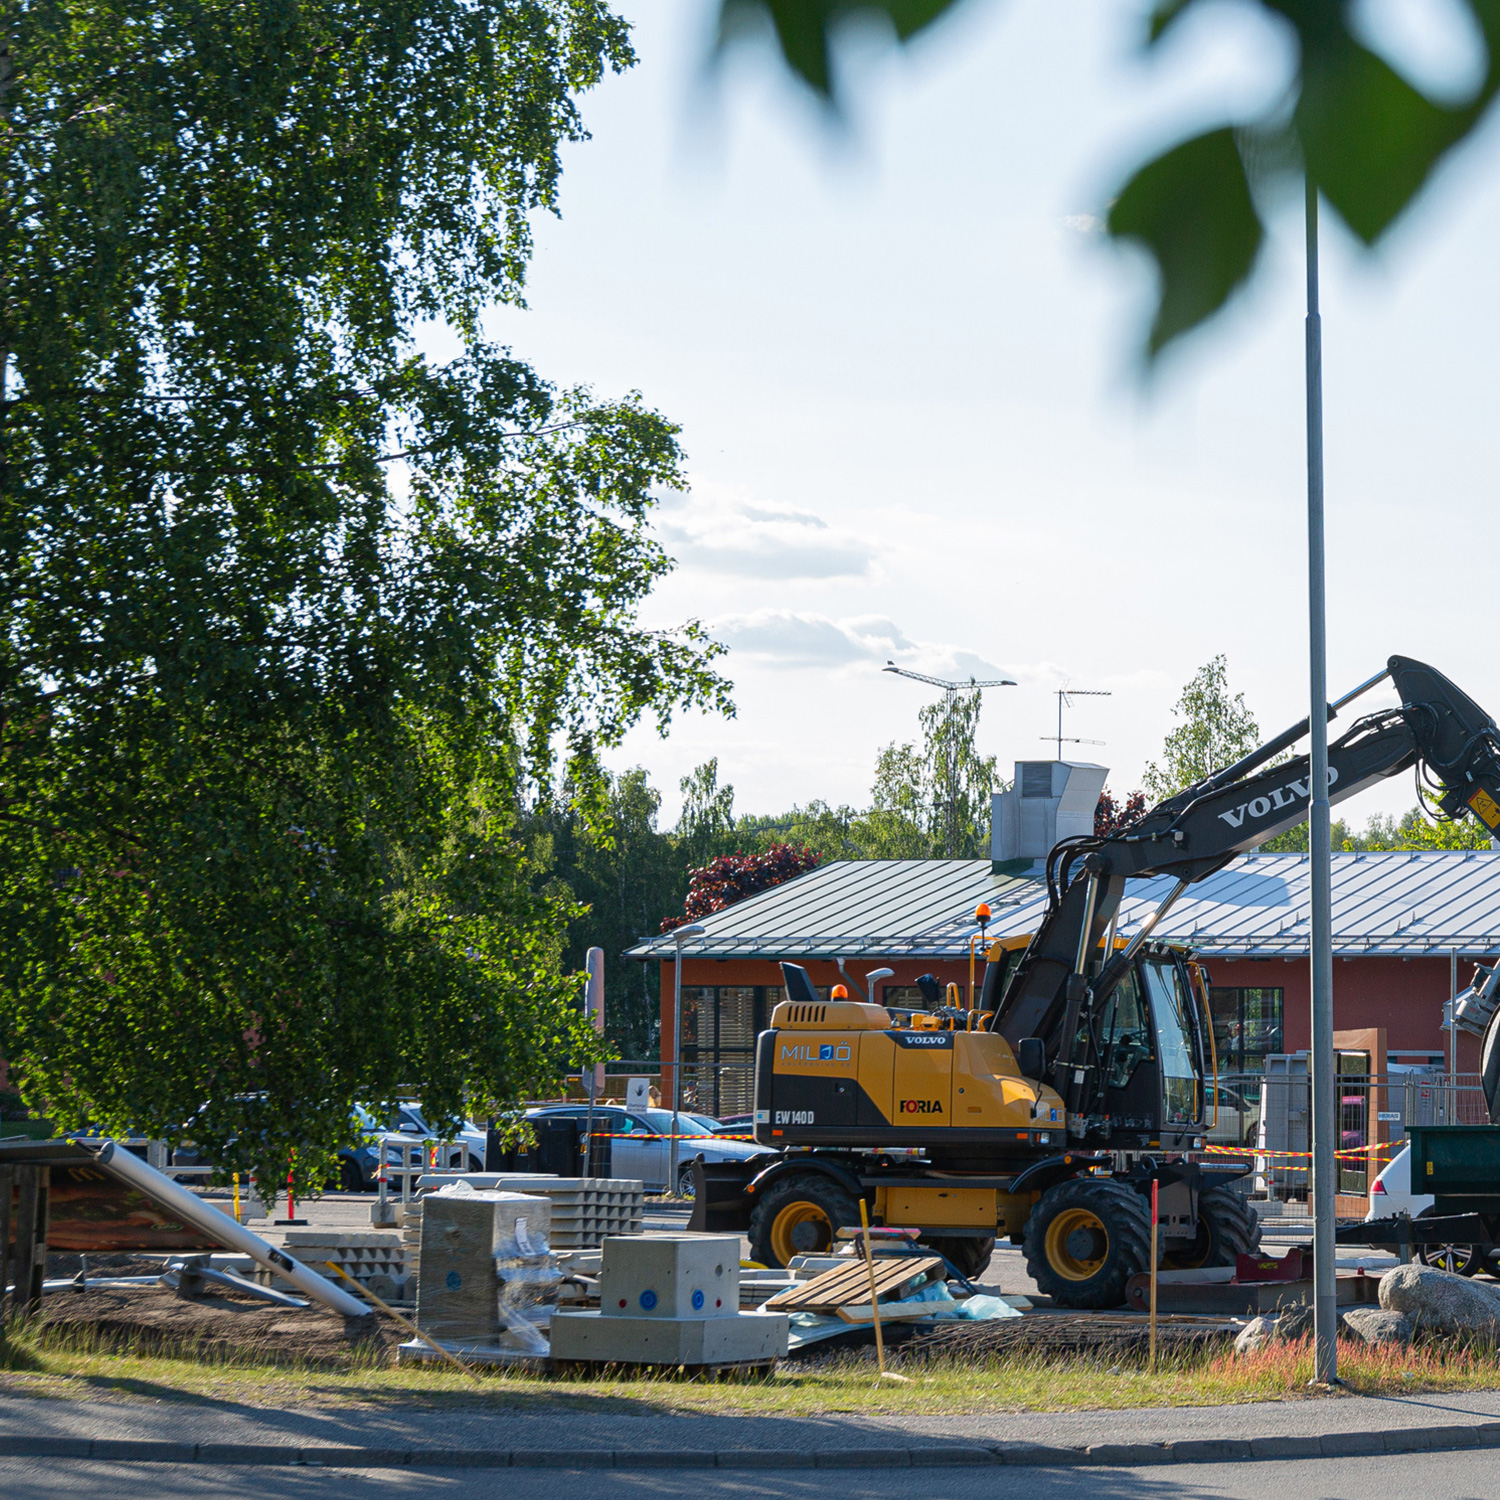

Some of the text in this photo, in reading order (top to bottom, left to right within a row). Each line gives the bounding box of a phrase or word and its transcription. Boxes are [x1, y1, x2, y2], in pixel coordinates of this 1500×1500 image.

[905, 1036, 946, 1045] VOLVO
[900, 1100, 943, 1113] FORIA
[775, 1110, 790, 1125] EW
